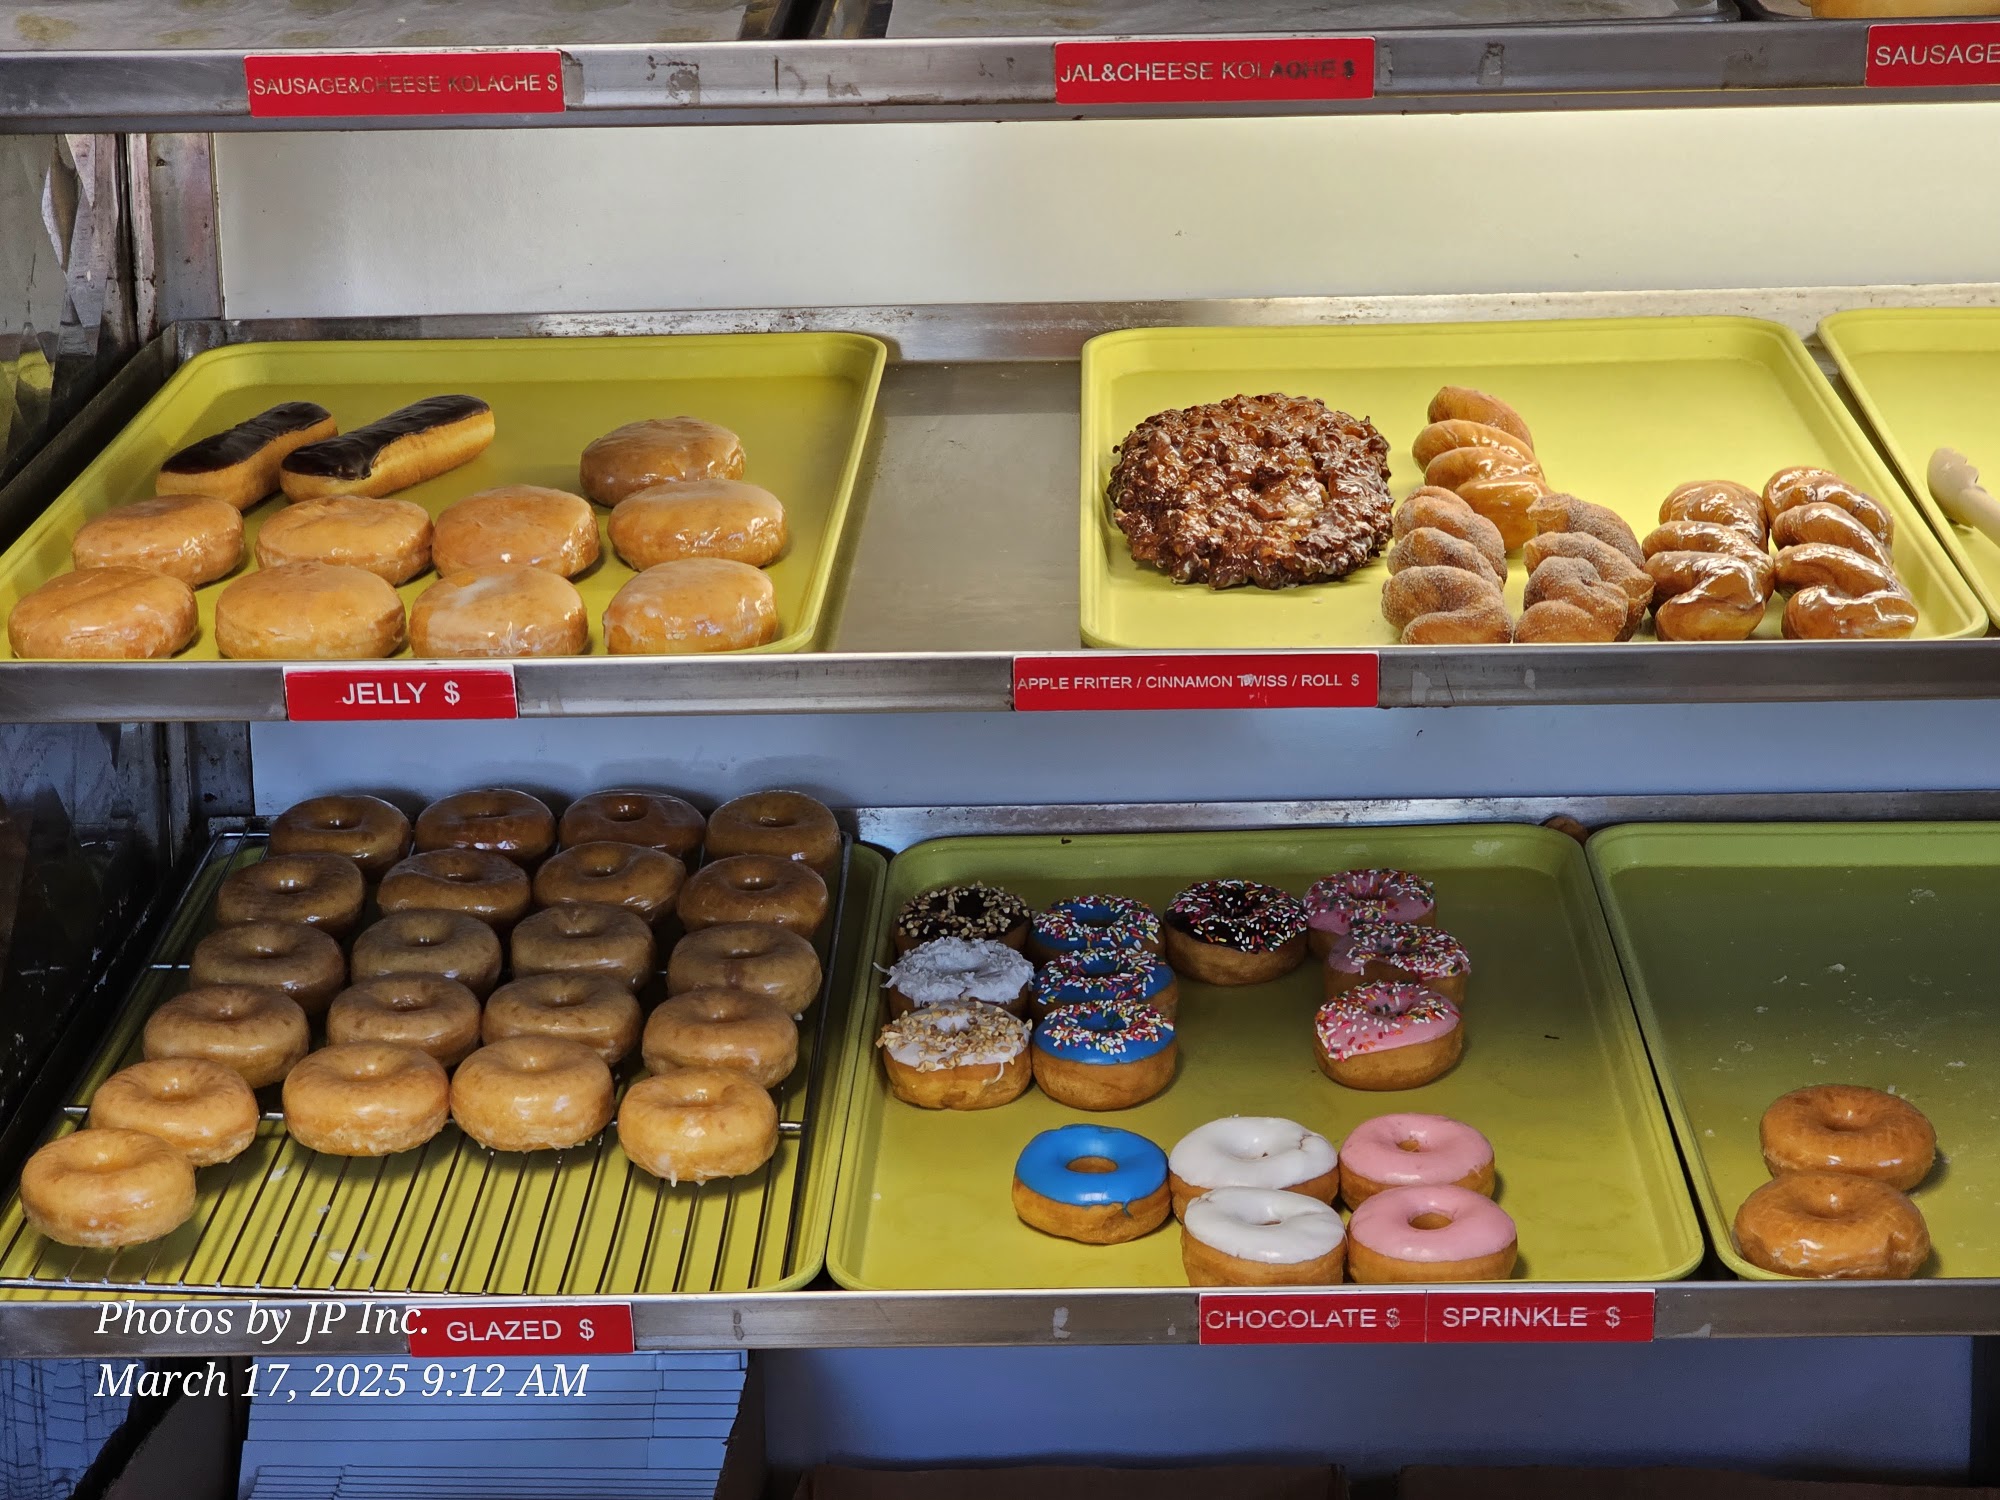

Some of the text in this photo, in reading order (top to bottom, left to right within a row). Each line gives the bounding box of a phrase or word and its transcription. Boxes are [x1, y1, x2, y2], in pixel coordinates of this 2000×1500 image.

[253, 75, 441, 96] SAUSAGE&CHEESE
[449, 74, 541, 93] KOLACHE
[1017, 676, 1069, 690] APPLE
[1074, 675, 1132, 689] FRITER
[1146, 675, 1232, 689] CINNAMON
[1301, 673, 1342, 687] ROLL
[1351, 672, 1360, 688] $
[342, 681, 461, 705] JELLY $
[1206, 1307, 1400, 1328] CHOCOLATE $
[1442, 1307, 1621, 1329] SPRINKLE $
[446, 1319, 595, 1342] GLAZED $
